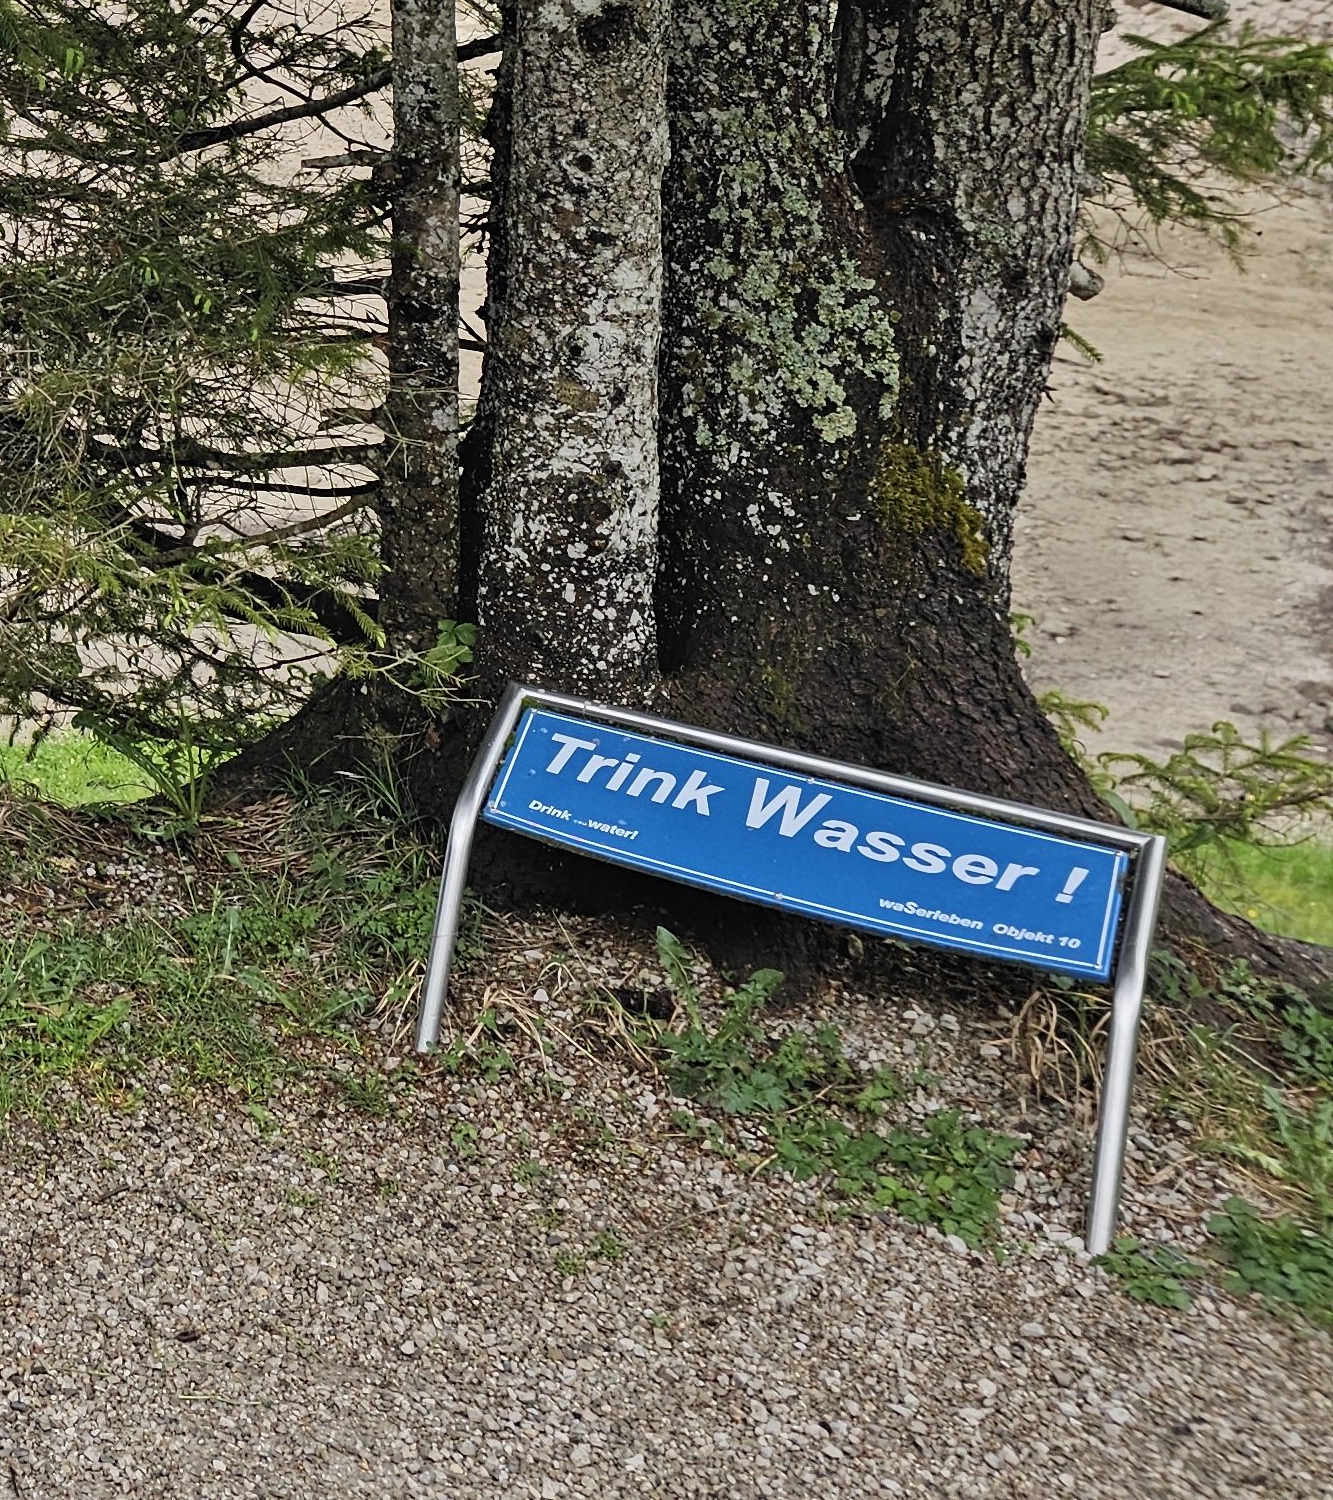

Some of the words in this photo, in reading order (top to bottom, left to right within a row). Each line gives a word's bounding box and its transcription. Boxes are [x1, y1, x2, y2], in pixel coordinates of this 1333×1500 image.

[528, 799, 573, 820] Drink
[588, 819, 639, 840] water!
[545, 733, 725, 816] Trink
[745, 777, 1041, 891] Wasser
[1055, 867, 1089, 903] !
[993, 923, 1055, 944] Objekt
[1058, 936, 1081, 949] 10
